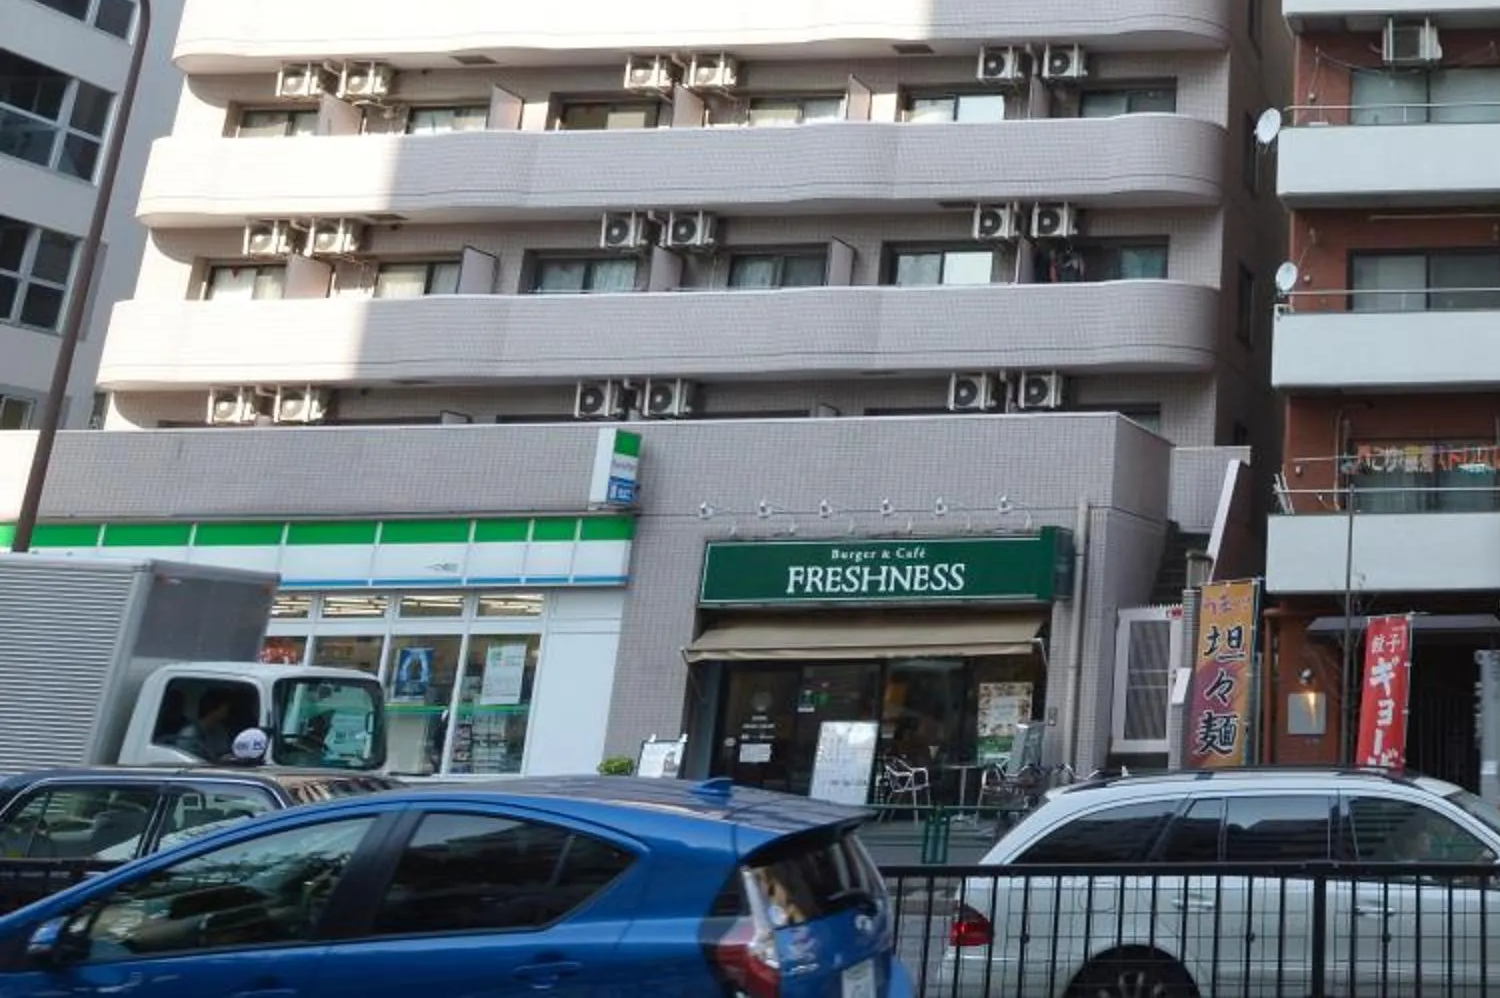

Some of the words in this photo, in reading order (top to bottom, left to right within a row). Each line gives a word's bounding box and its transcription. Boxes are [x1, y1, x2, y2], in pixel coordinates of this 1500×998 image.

[831, 549, 876, 562] Burger
[881, 550, 891, 559] &
[895, 546, 926, 559] Café
[786, 563, 965, 594] FRESHNESS
